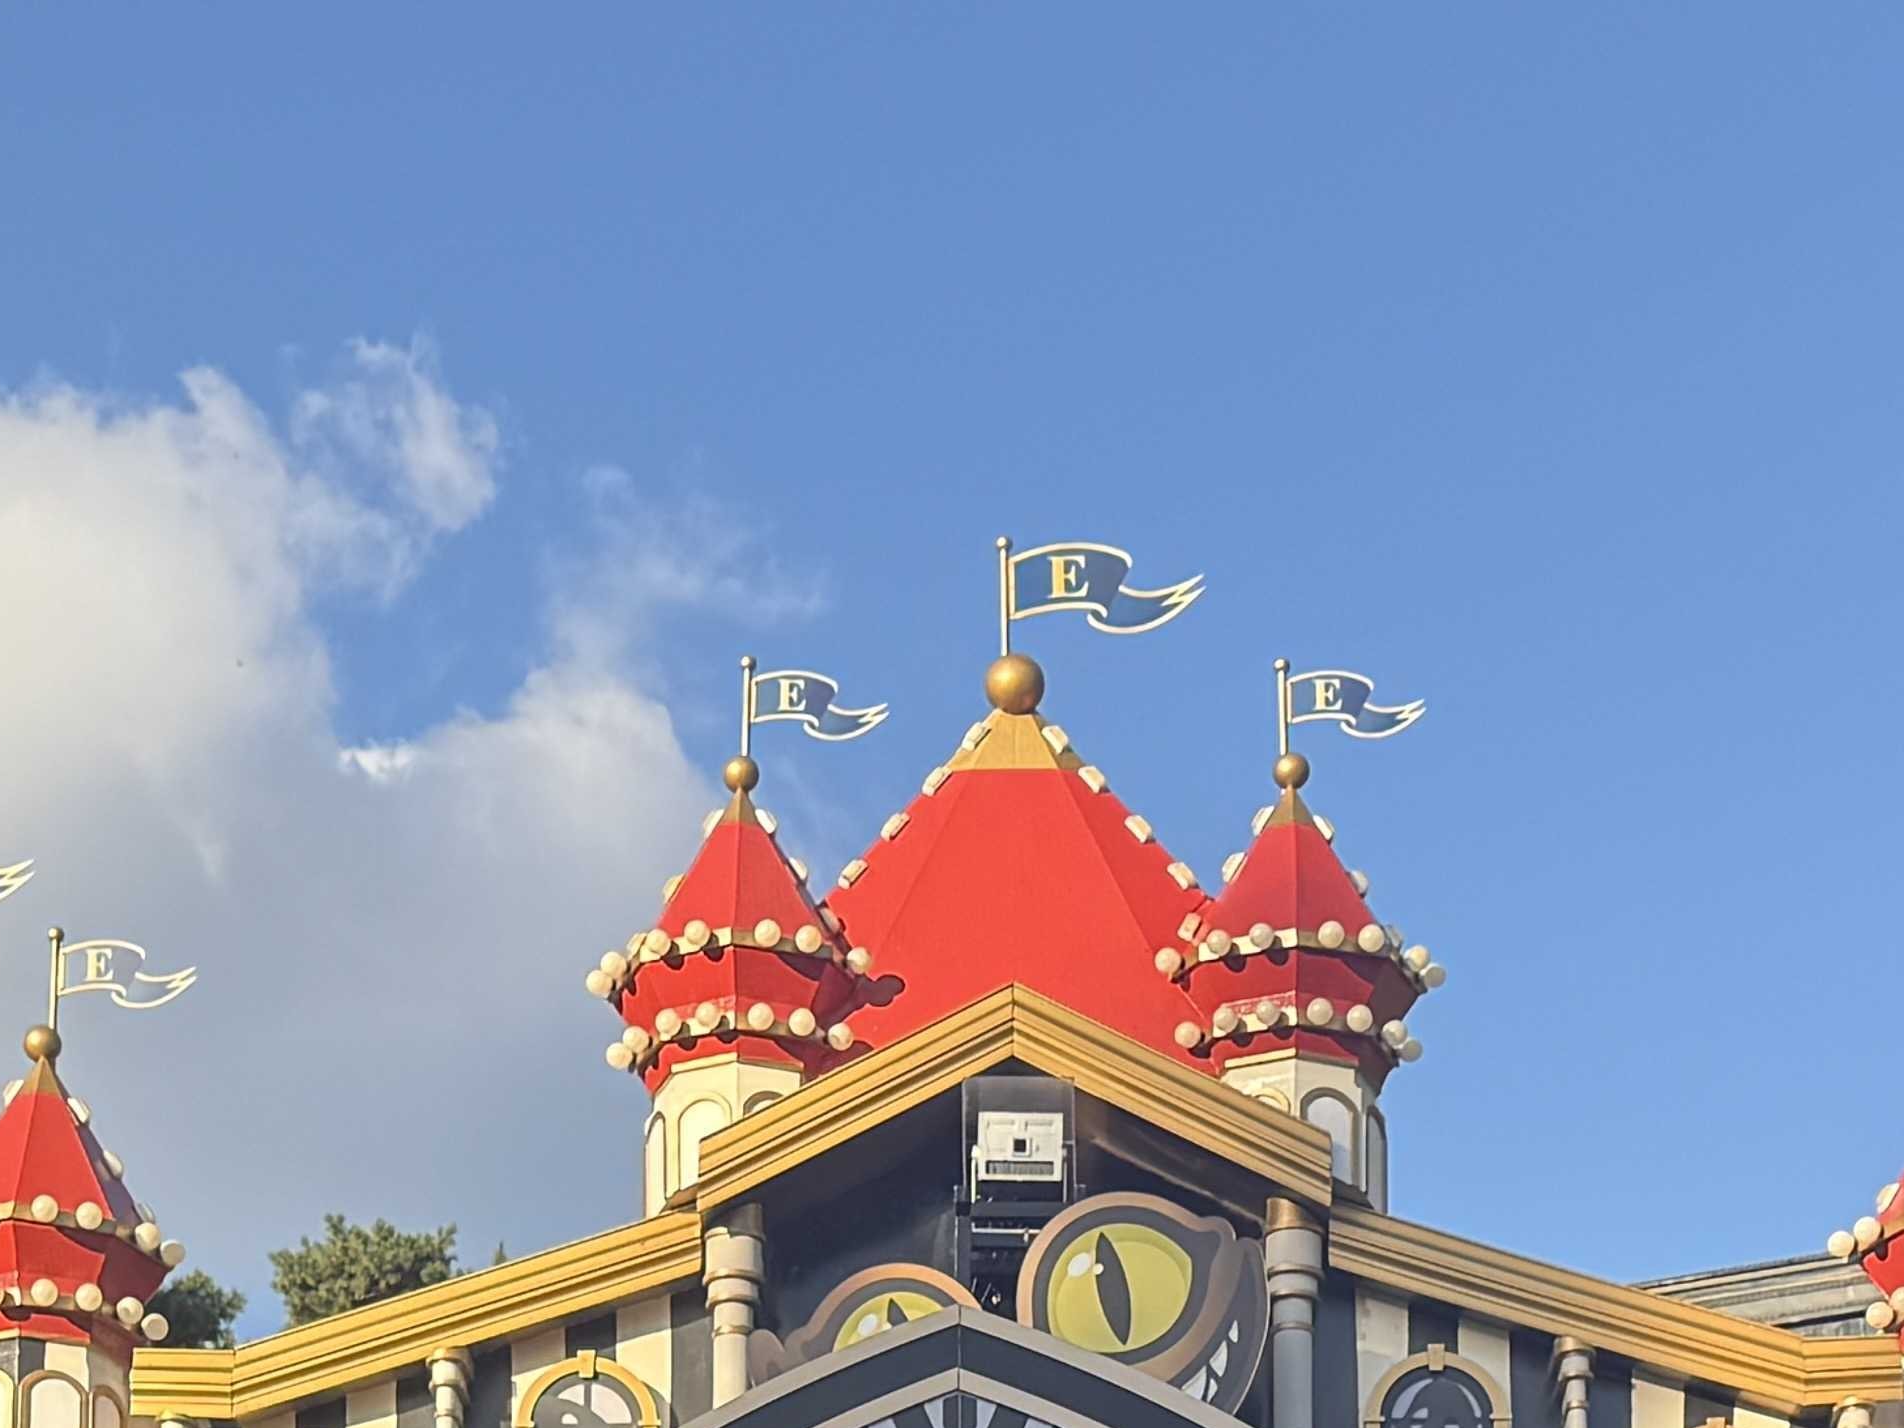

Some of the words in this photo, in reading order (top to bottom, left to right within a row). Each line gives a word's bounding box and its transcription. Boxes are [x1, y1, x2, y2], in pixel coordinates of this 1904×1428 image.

[1048, 555, 1089, 599] E
[778, 678, 807, 711] E
[1313, 678, 1344, 711] E
[83, 947, 116, 982] E
